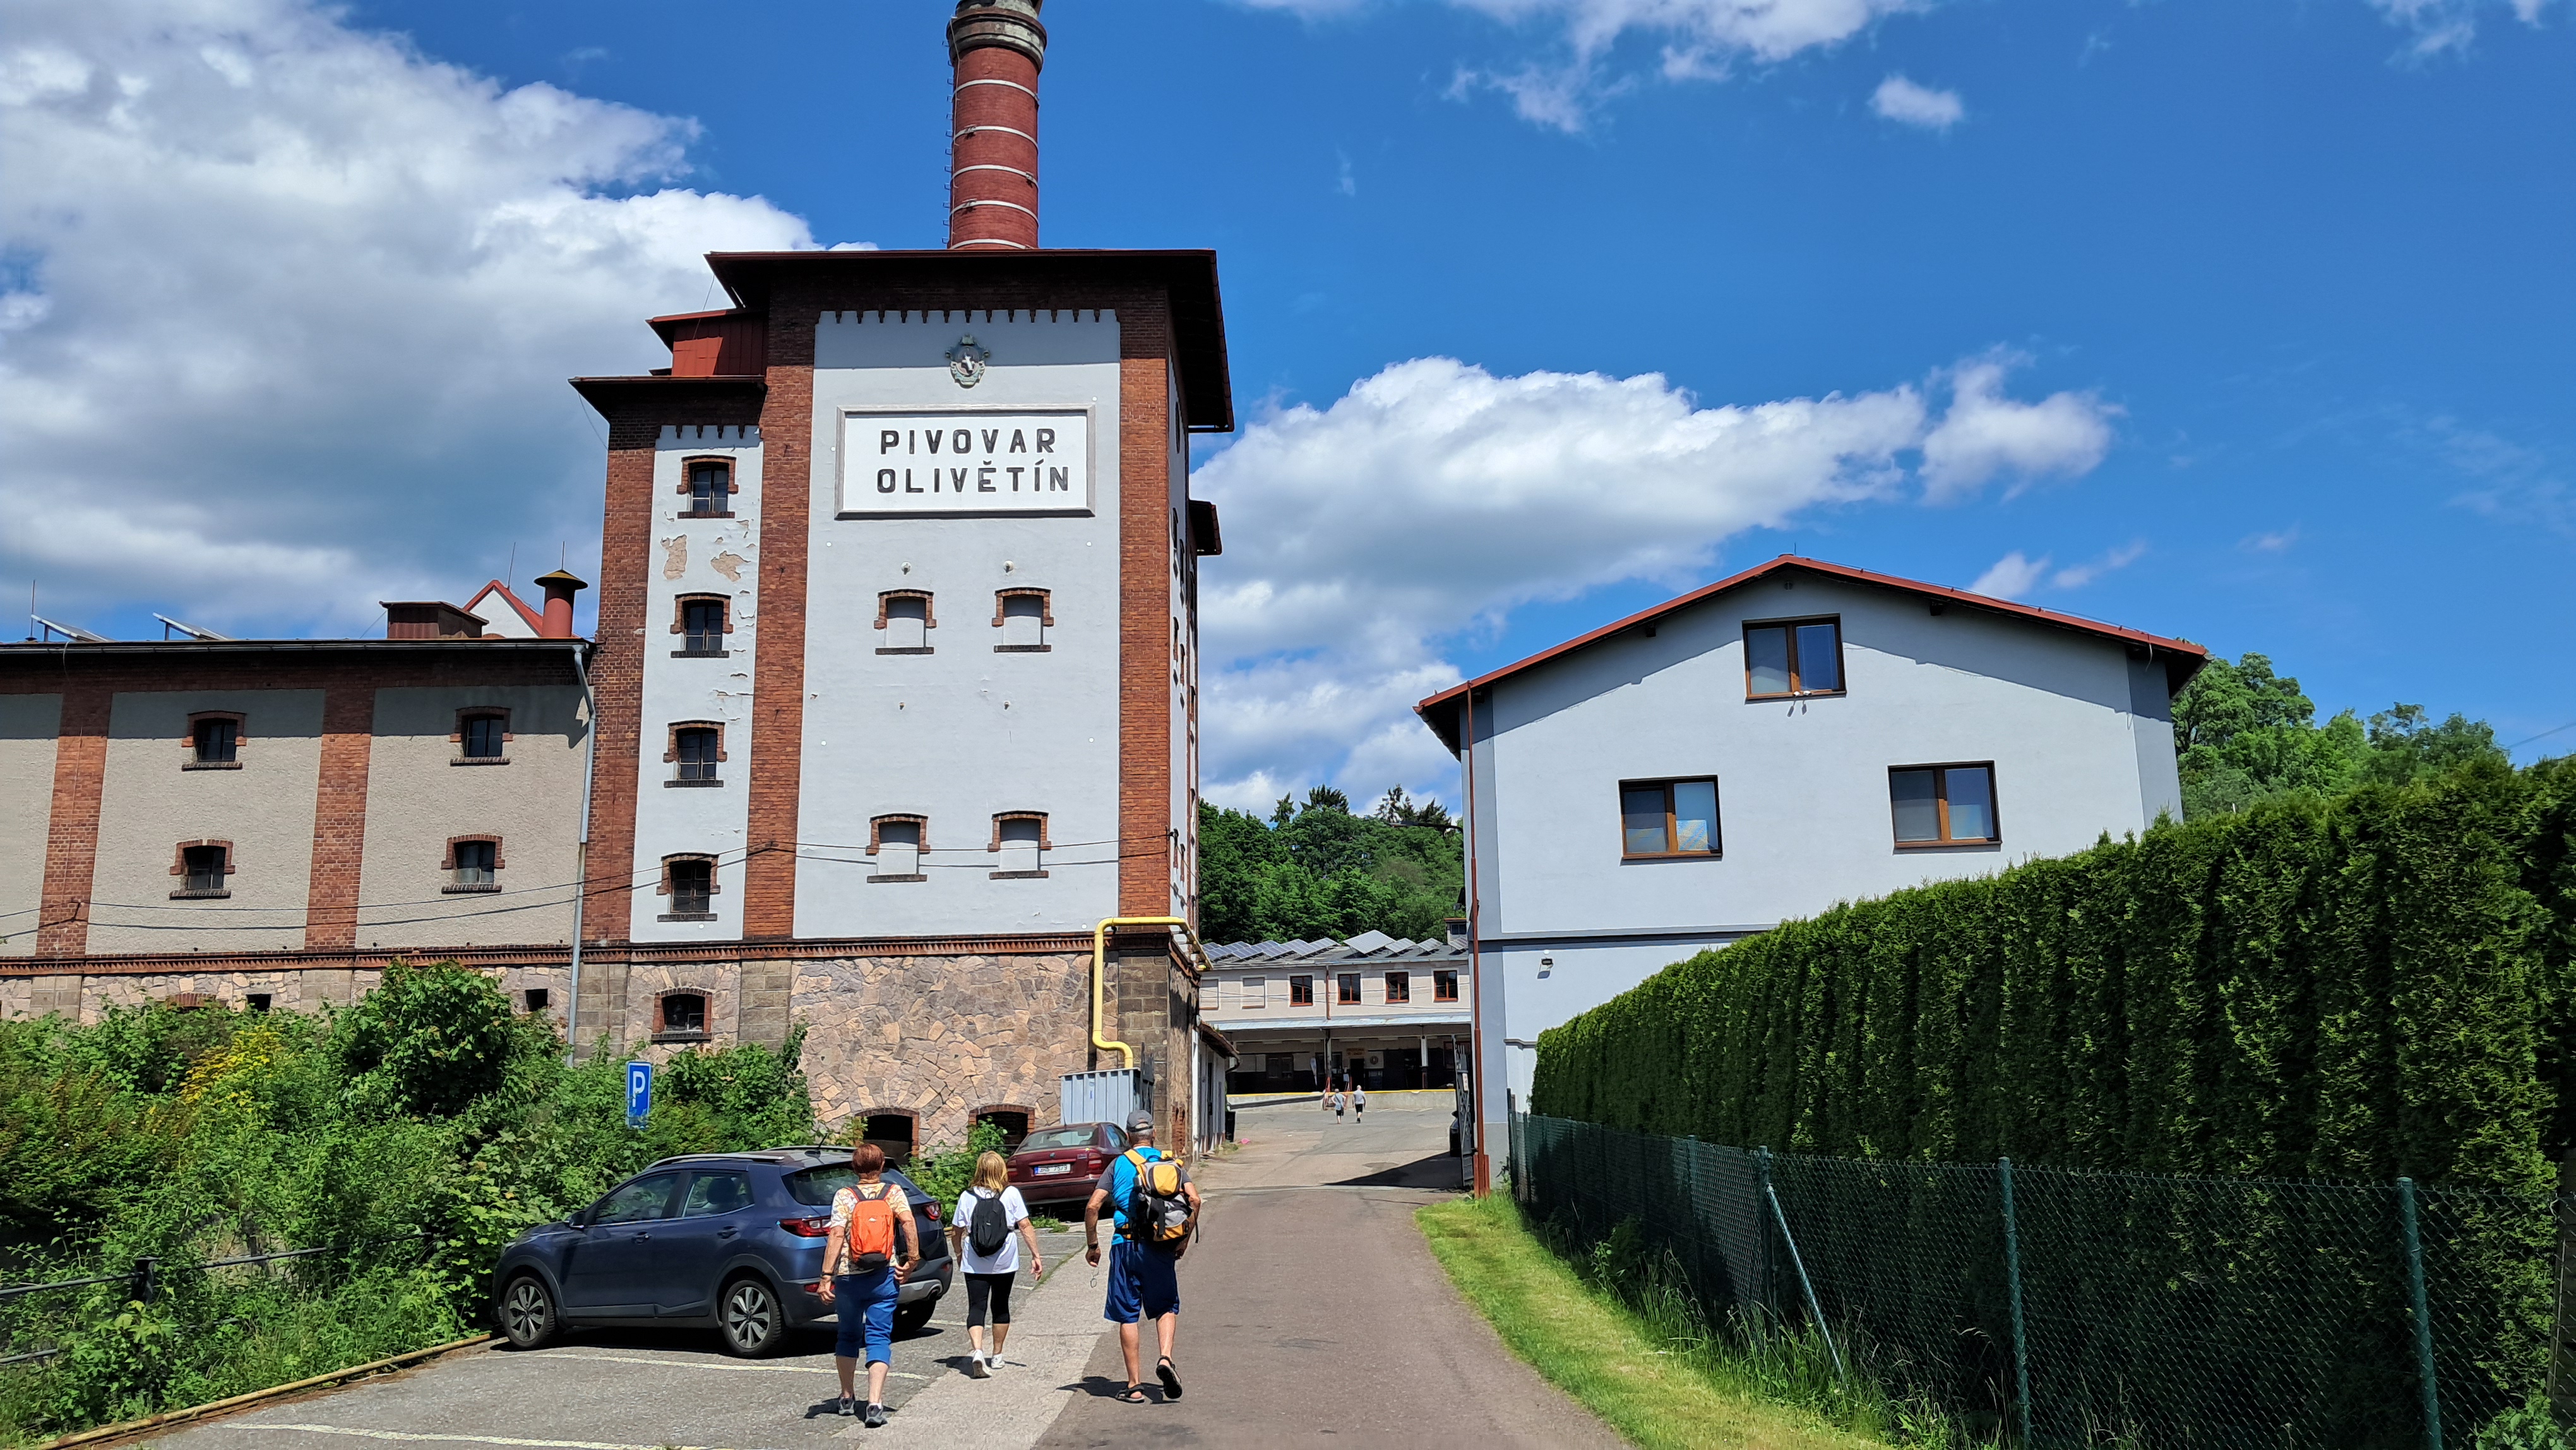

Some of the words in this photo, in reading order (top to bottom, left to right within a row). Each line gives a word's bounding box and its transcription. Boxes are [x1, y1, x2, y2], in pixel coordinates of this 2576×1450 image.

[881, 429, 1054, 454] PIVOVAR
[878, 459, 1068, 493] OLIVĚTÍN
[633, 1070, 646, 1107] P
